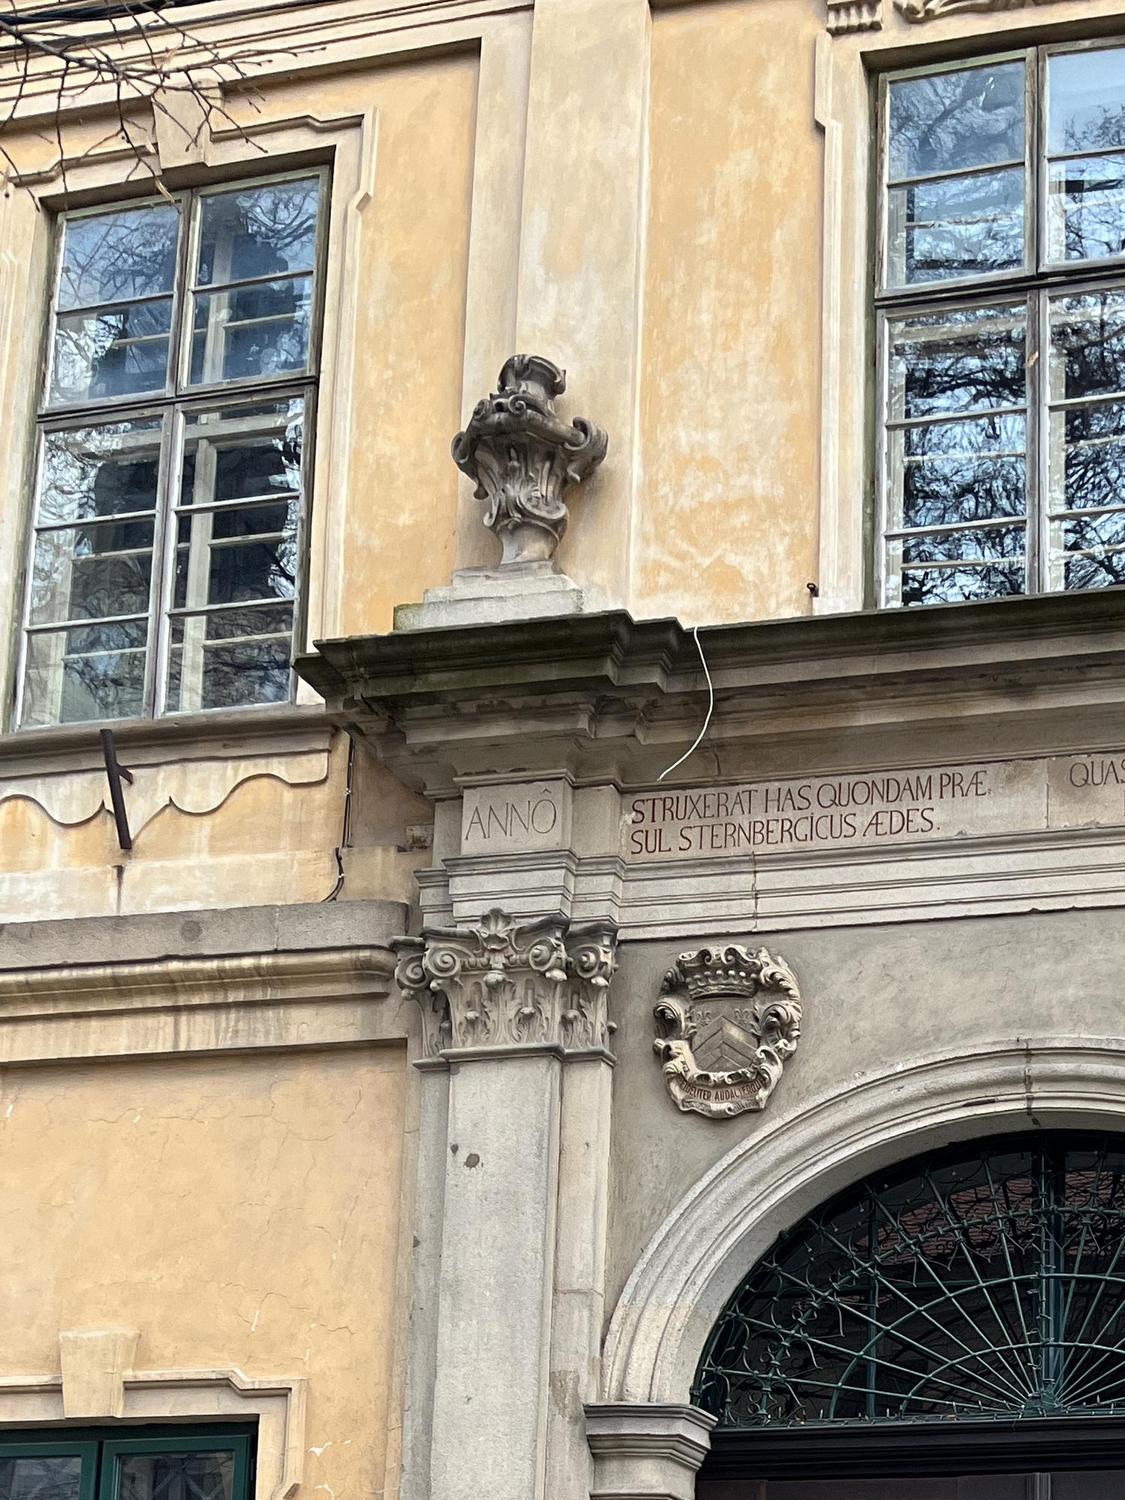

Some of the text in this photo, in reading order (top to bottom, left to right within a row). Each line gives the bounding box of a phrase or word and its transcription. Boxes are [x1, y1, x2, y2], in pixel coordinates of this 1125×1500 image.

[631, 788, 758, 824] STRUXERAT
[764, 784, 812, 813] HAS
[816, 774, 932, 809] QUONDAM
[631, 828, 672, 855] SUL
